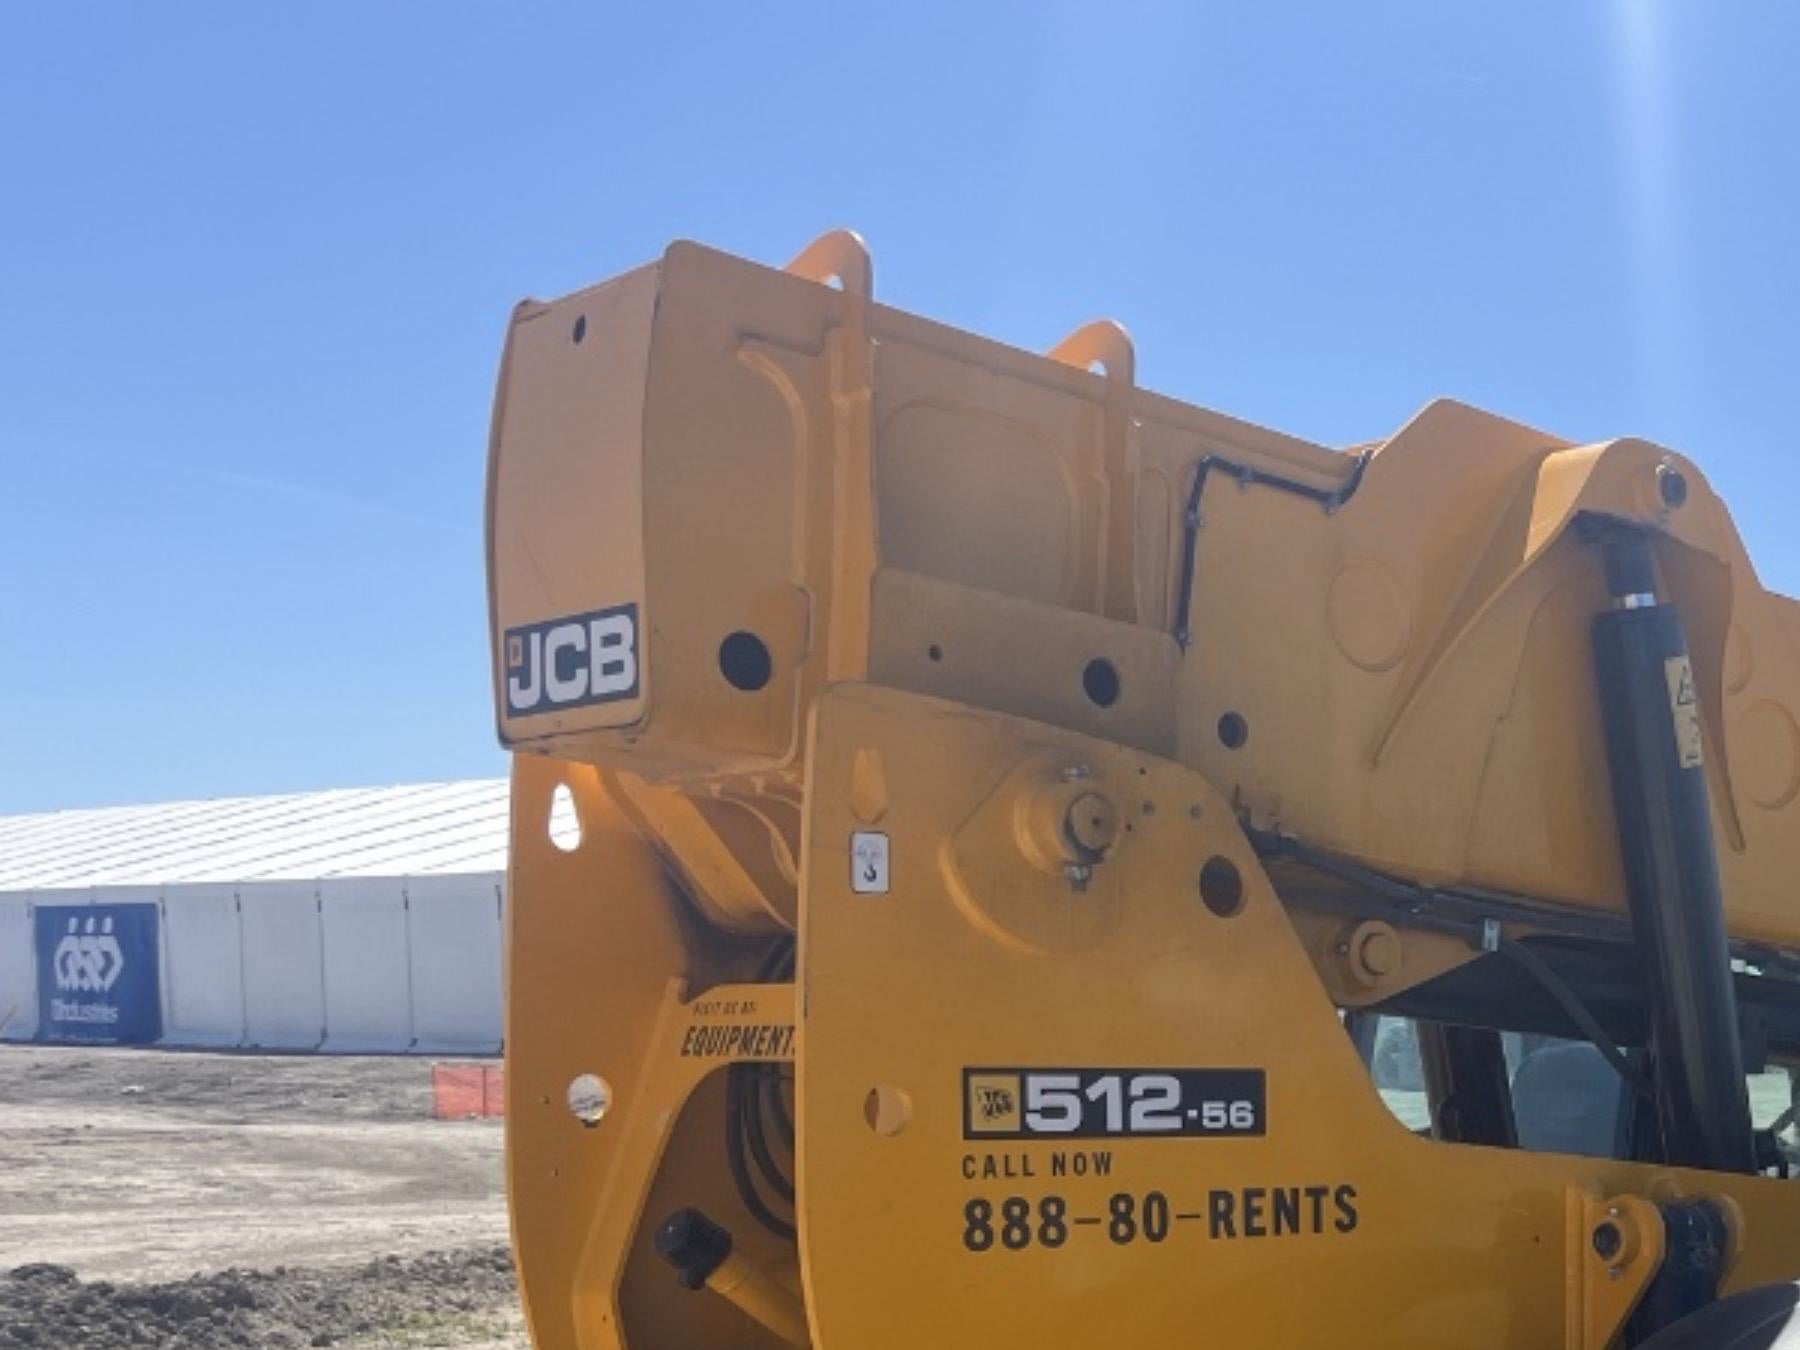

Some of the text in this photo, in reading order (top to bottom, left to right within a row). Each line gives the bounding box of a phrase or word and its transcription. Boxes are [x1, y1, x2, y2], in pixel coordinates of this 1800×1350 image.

[509, 613, 637, 710] JCB
[681, 1025, 796, 1057] EQUIPMENT
[962, 1151, 1113, 1180] CALL NOW
[962, 1184, 1359, 1252] 888-80-RENTS
